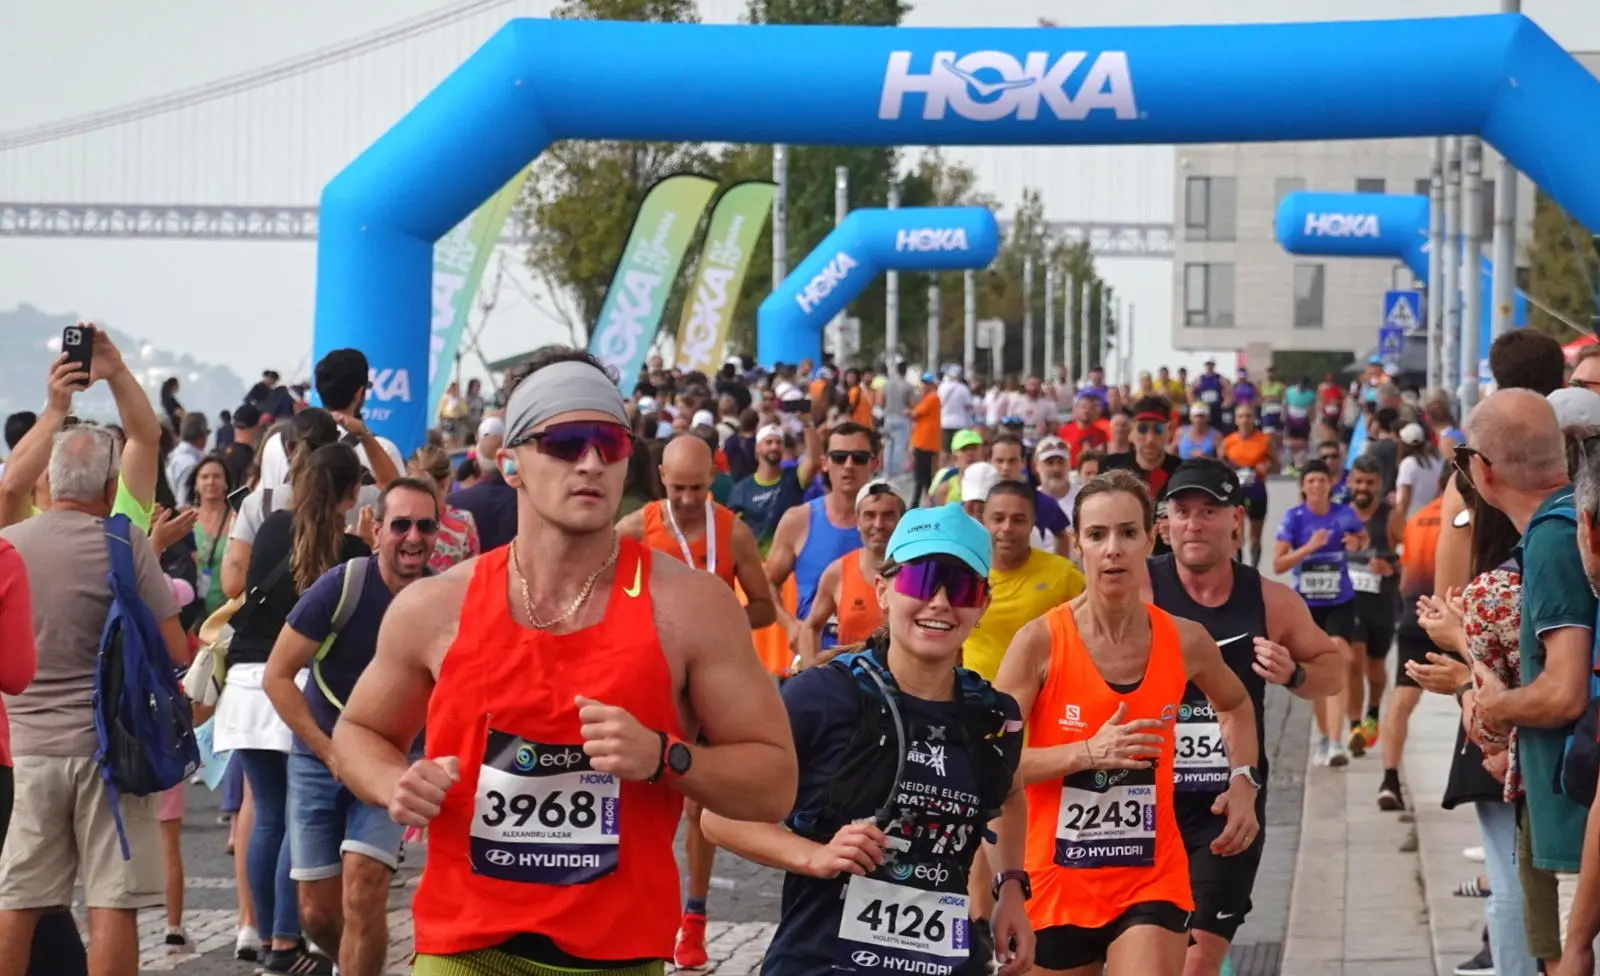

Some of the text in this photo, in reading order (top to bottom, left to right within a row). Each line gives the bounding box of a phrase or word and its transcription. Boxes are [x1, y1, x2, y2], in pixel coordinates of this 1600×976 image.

[878, 51, 1138, 121] HOKA
[1304, 213, 1381, 238] HOKA
[895, 228, 968, 251] HOKA
[795, 251, 858, 315] HOKA
[598, 269, 661, 380] OKA
[365, 367, 410, 402] KA
[540, 748, 581, 768] edp
[907, 752, 926, 764] RIS
[1175, 736, 1226, 758] 354
[579, 774, 614, 784] HOKA
[1185, 772, 1228, 782] HYUNDA
[900, 781, 979, 806] NEIDER ELECTR
[1128, 787, 1151, 796] HOKA
[482, 790, 596, 828] 3968
[1065, 800, 1141, 830] 2243
[519, 853, 600, 868] HYUNDAI
[1089, 845, 1143, 857] HYUNDAI
[914, 863, 949, 886] edp
[939, 896, 965, 907] HOKA
[857, 899, 945, 942] 4126
[883, 956, 953, 976] HYUNDAI
